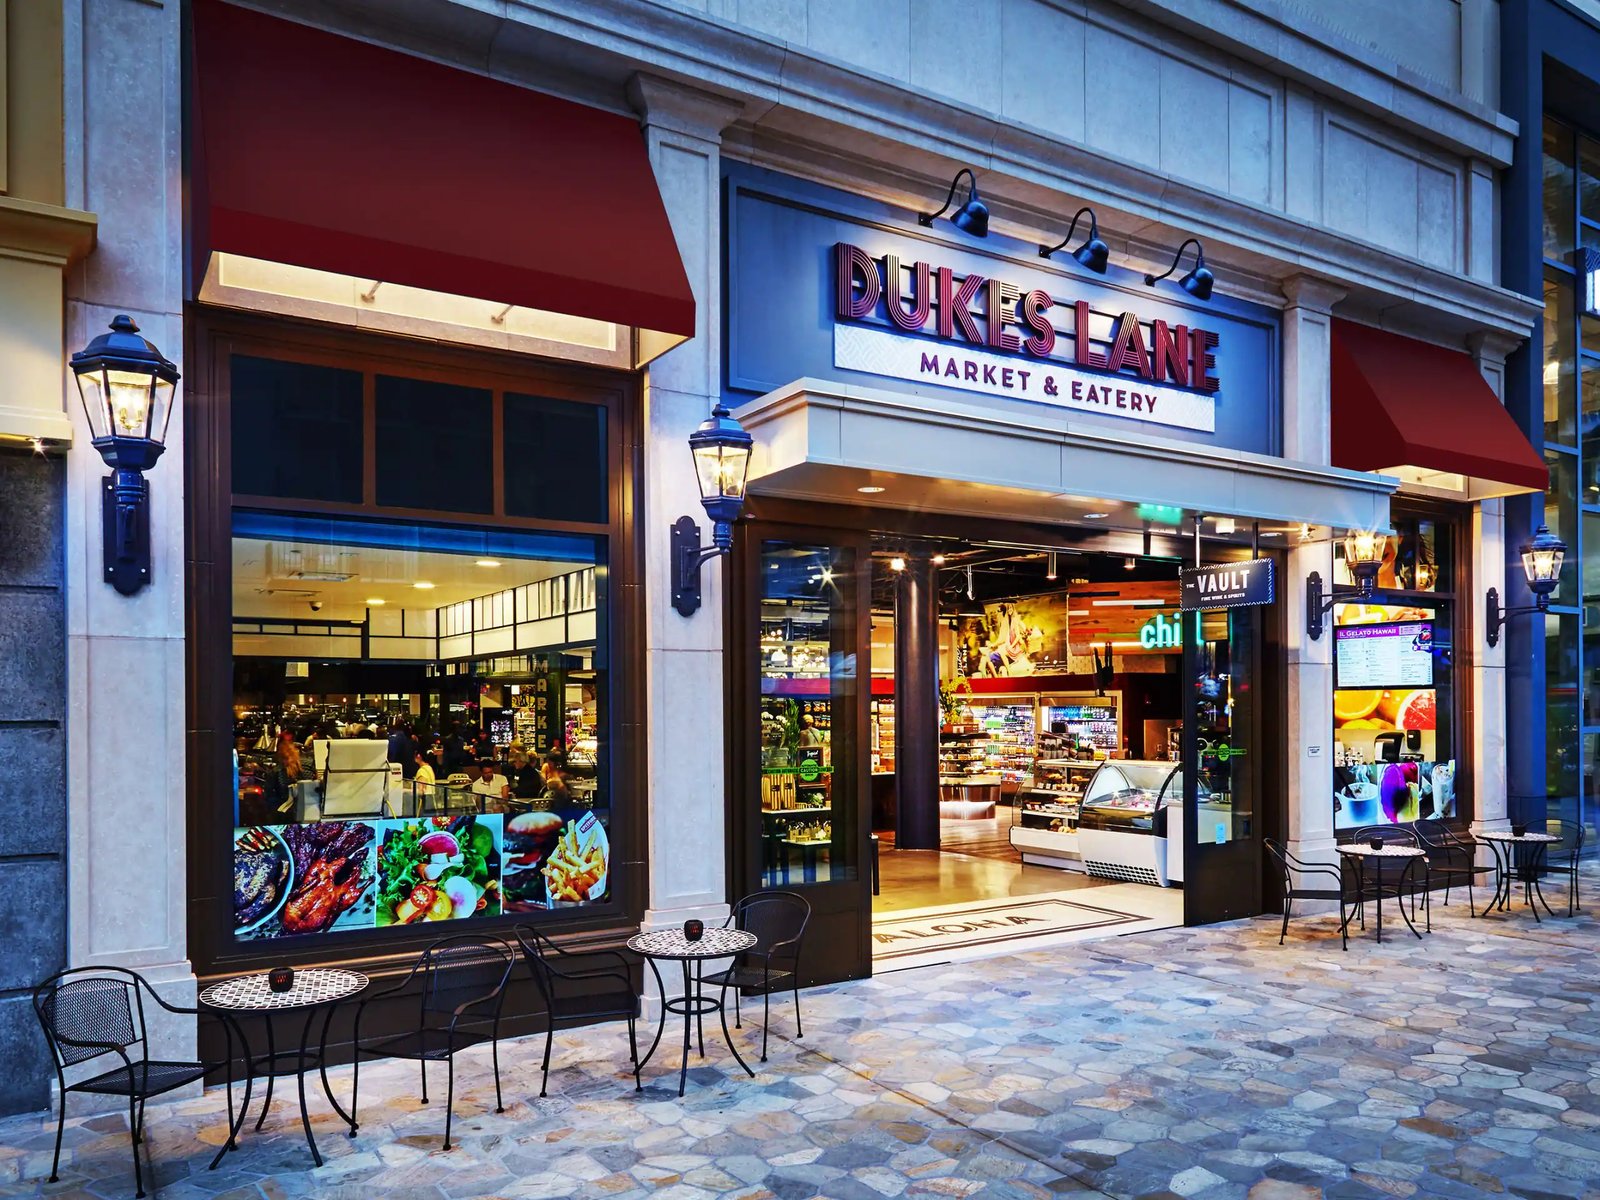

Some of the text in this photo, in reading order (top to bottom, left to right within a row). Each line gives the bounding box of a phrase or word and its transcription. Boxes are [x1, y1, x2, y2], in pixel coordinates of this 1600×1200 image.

[836, 242, 1221, 393] DUKES LANE
[920, 352, 1157, 413] MARKET & EATERY
[1197, 569, 1250, 593] VAULT
[872, 916, 1048, 944] ALOHA
